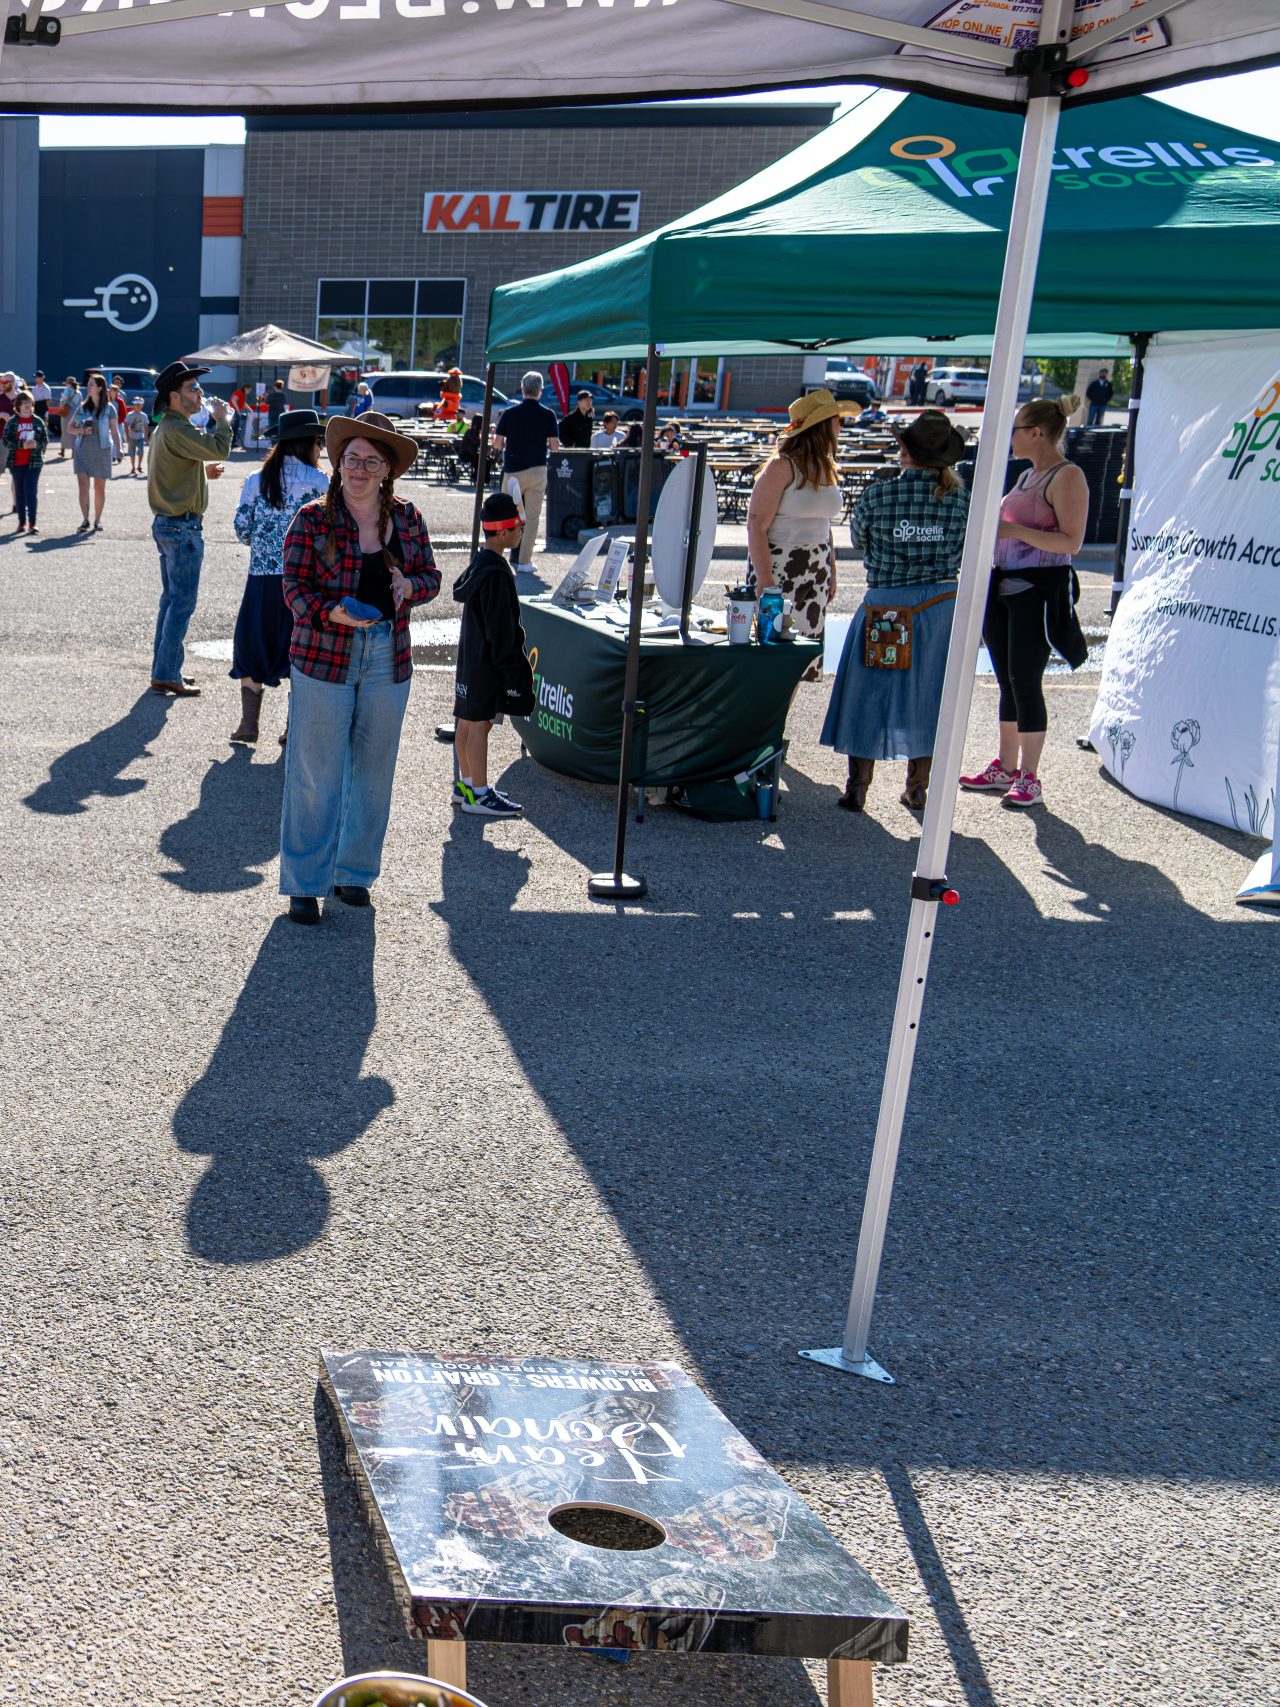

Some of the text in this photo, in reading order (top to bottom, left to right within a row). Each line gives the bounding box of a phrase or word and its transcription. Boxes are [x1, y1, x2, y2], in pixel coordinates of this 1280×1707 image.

[962, 21, 1003, 36] ONLINE
[1071, 22, 1095, 36] SHOP
[426, 193, 639, 230] KAL TIRE
[1157, 597, 1280, 637] GROWWITHTRELLIS.
[539, 676, 574, 719] trellis
[538, 710, 573, 742] SOCIETY
[373, 1368, 502, 1386] GRAFTON
[431, 1361, 485, 1371] FOOD
[562, 1367, 646, 1377] HALIFAX
[527, 1374, 659, 1393] BLOWERS
[419, 1415, 687, 1458] Donair
[454, 1443, 683, 1485] Team
